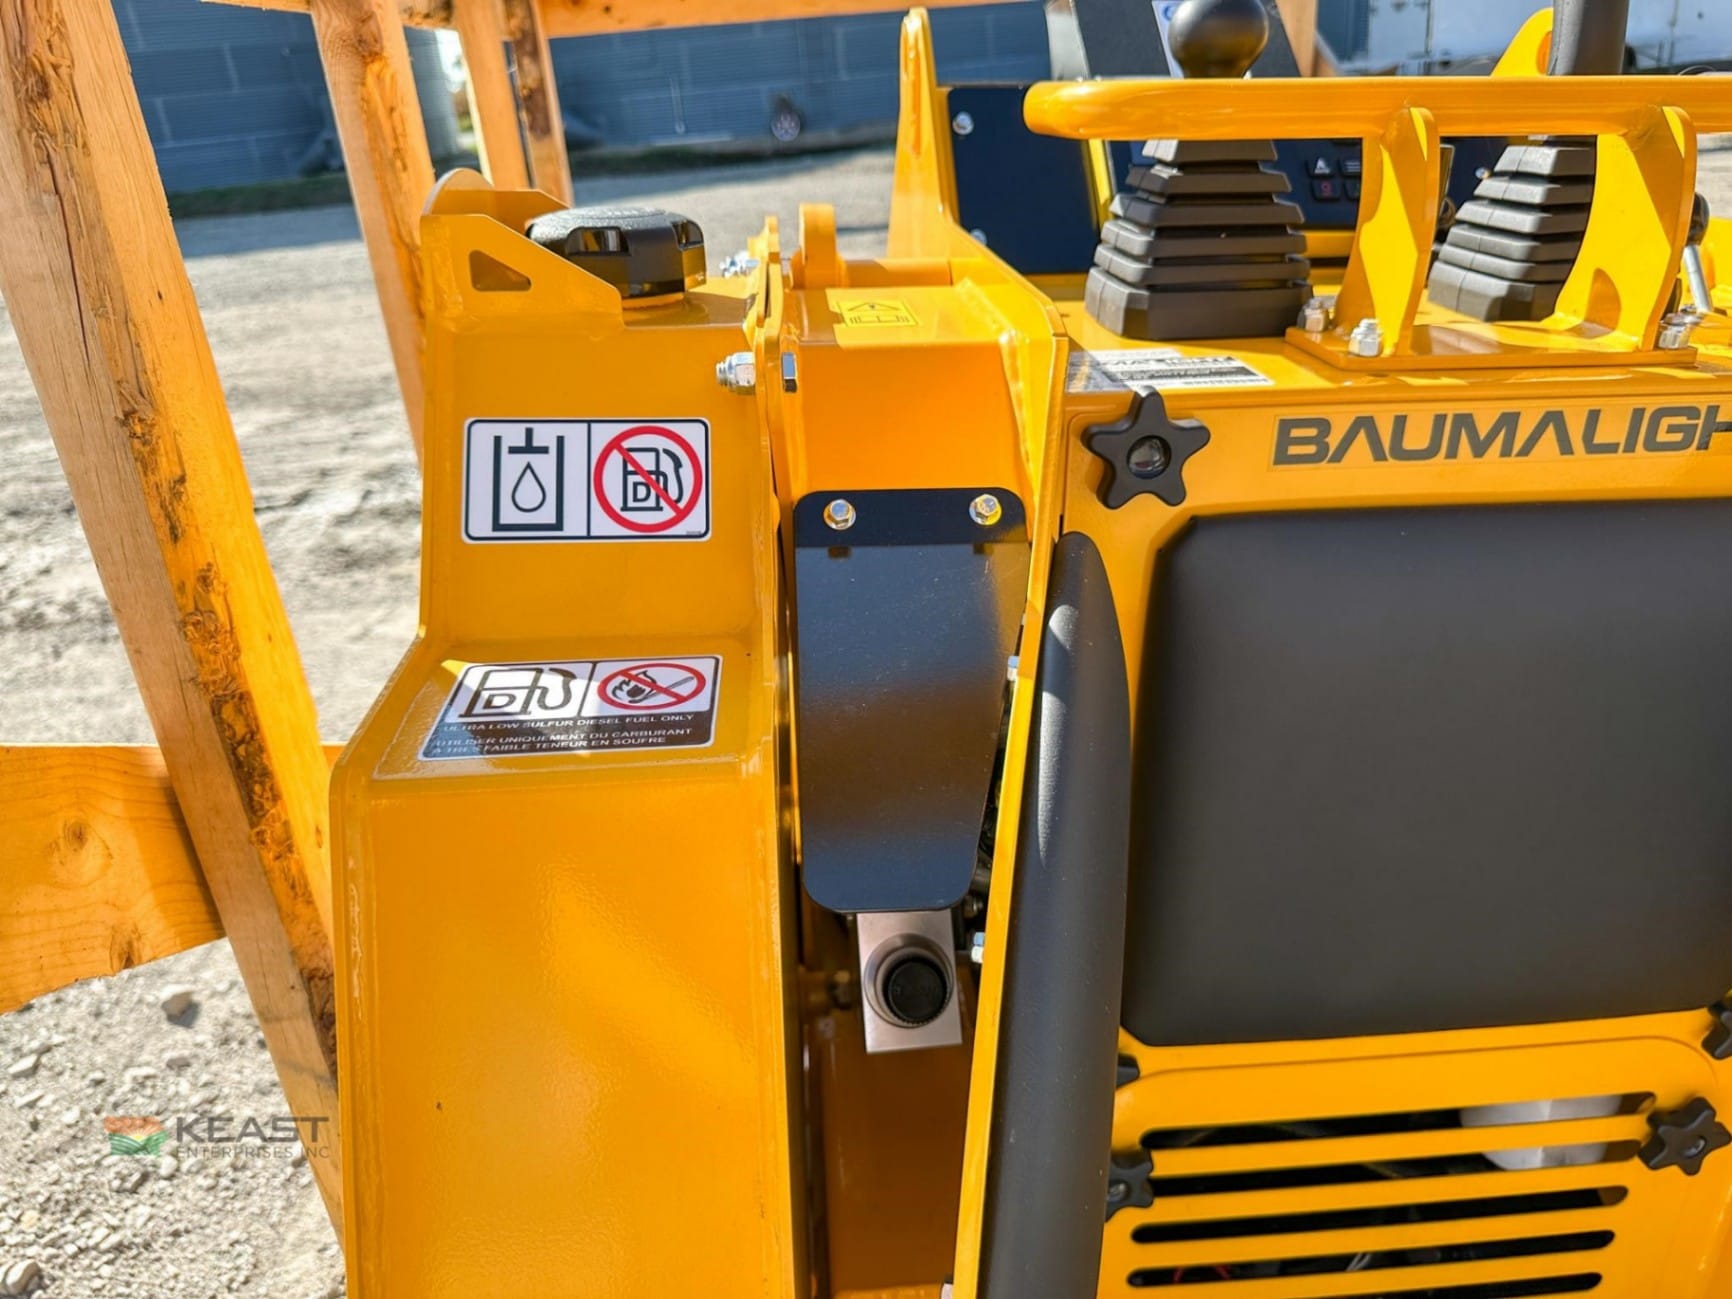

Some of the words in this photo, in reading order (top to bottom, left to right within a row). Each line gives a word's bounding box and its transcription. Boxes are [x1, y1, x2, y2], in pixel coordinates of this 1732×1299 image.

[632, 481, 652, 503] D
[482, 693, 517, 709] D
[444, 723, 486, 731] ULTRA
[489, 722, 520, 730] LOW
[523, 719, 574, 729] SULFUR
[577, 717, 621, 726] DIESEL
[625, 715, 656, 724] FUEL
[482, 743, 531, 752] FAIBLE
[536, 740, 588, 749] TENEUR
[591, 738, 610, 746] EN
[612, 736, 666, 745] SOUFRE
[499, 733, 585, 744] UNIQUEMENT
[589, 731, 608, 740] DU
[612, 728, 692, 738] CARBURANT
